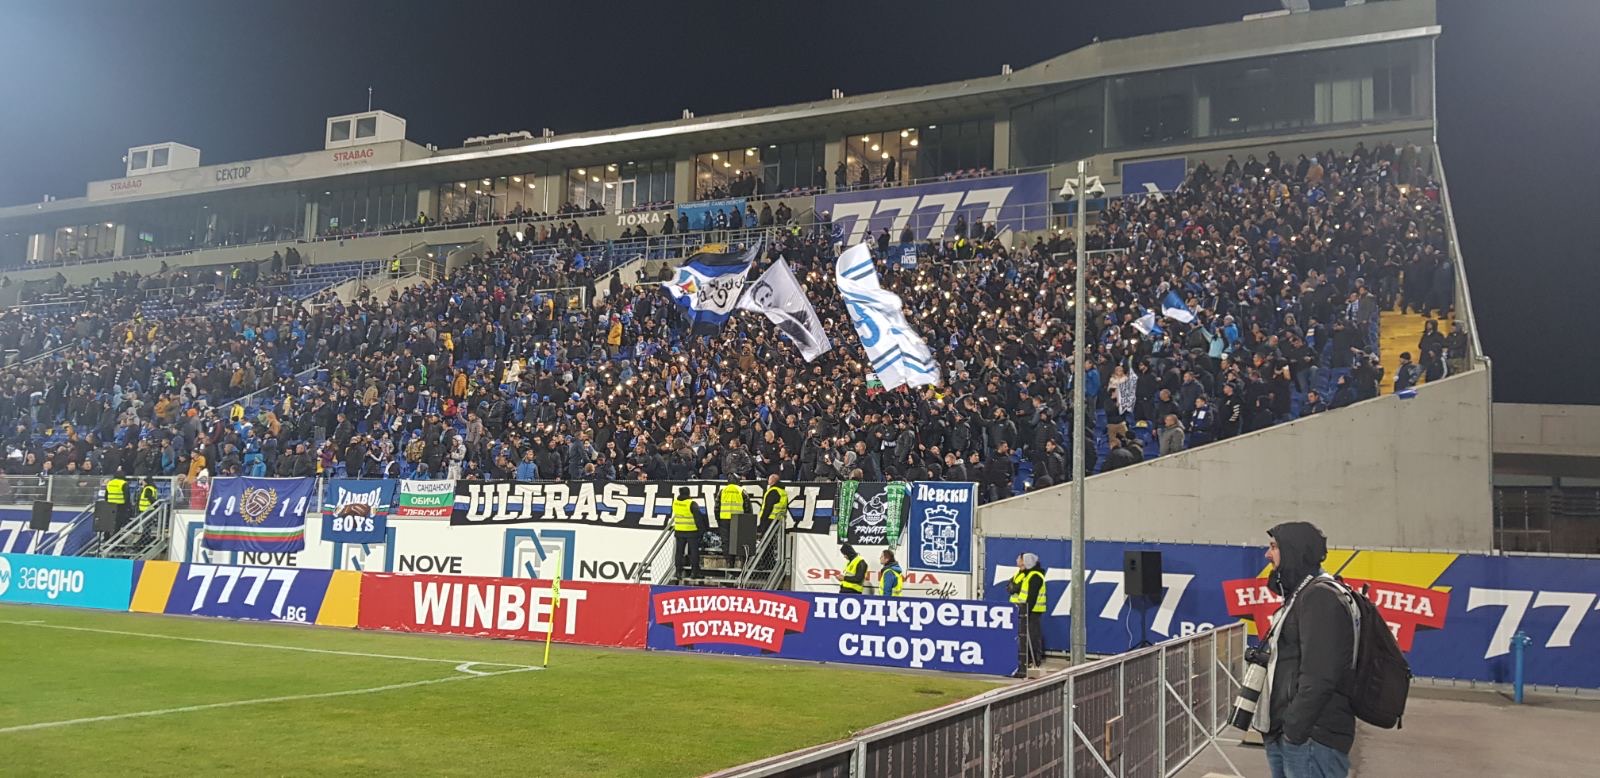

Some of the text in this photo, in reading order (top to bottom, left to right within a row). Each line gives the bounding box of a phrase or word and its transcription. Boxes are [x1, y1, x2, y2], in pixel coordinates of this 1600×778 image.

[333, 148, 374, 161] STRABAG
[216, 166, 251, 181] СЕКТОР
[110, 179, 142, 191] STRABAG
[617, 212, 660, 226] ЛОЖА
[832, 186, 1013, 246] 7777
[337, 486, 381, 507] YAMBOL
[417, 483, 451, 492] САНДАНСКИ
[916, 484, 968, 502] Левски
[411, 497, 440, 505] ОБИЧА
[466, 483, 629, 523] ULTRAS
[332, 515, 374, 532] BOYS
[854, 525, 887, 534] PRIVATE
[858, 535, 884, 543] PARTY
[243, 551, 296, 566] NOVE
[399, 555, 462, 574] NOVE
[580, 560, 652, 580] NOVE
[413, 581, 587, 635] WINBET
[662, 595, 798, 623] НАЦИОНАЛНА
[814, 596, 1014, 631] подкрепя
[682, 620, 775, 644] ЛОТАРИЯ
[1466, 586, 1600, 660] 77
[838, 632, 984, 668] спорта
